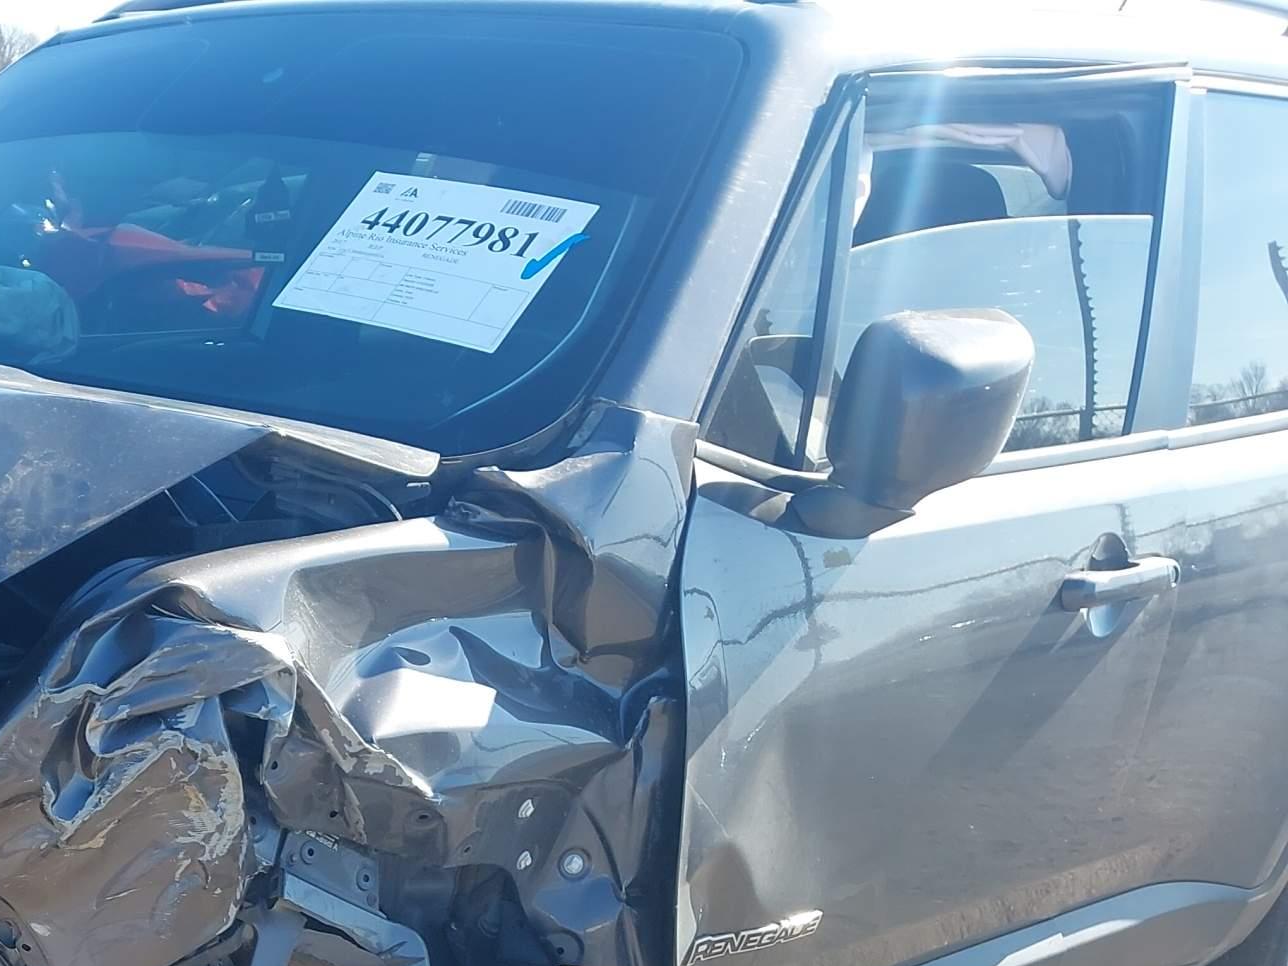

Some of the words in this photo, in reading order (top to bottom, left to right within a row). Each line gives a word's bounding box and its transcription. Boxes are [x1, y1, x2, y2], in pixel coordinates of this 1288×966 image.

[337, 228, 367, 240] Alpine
[368, 232, 385, 242] Rio
[386, 235, 430, 249] Insurance
[431, 242, 468, 257] Services
[361, 207, 540, 258] 44077981
[687, 909, 824, 966] RENEGADE
